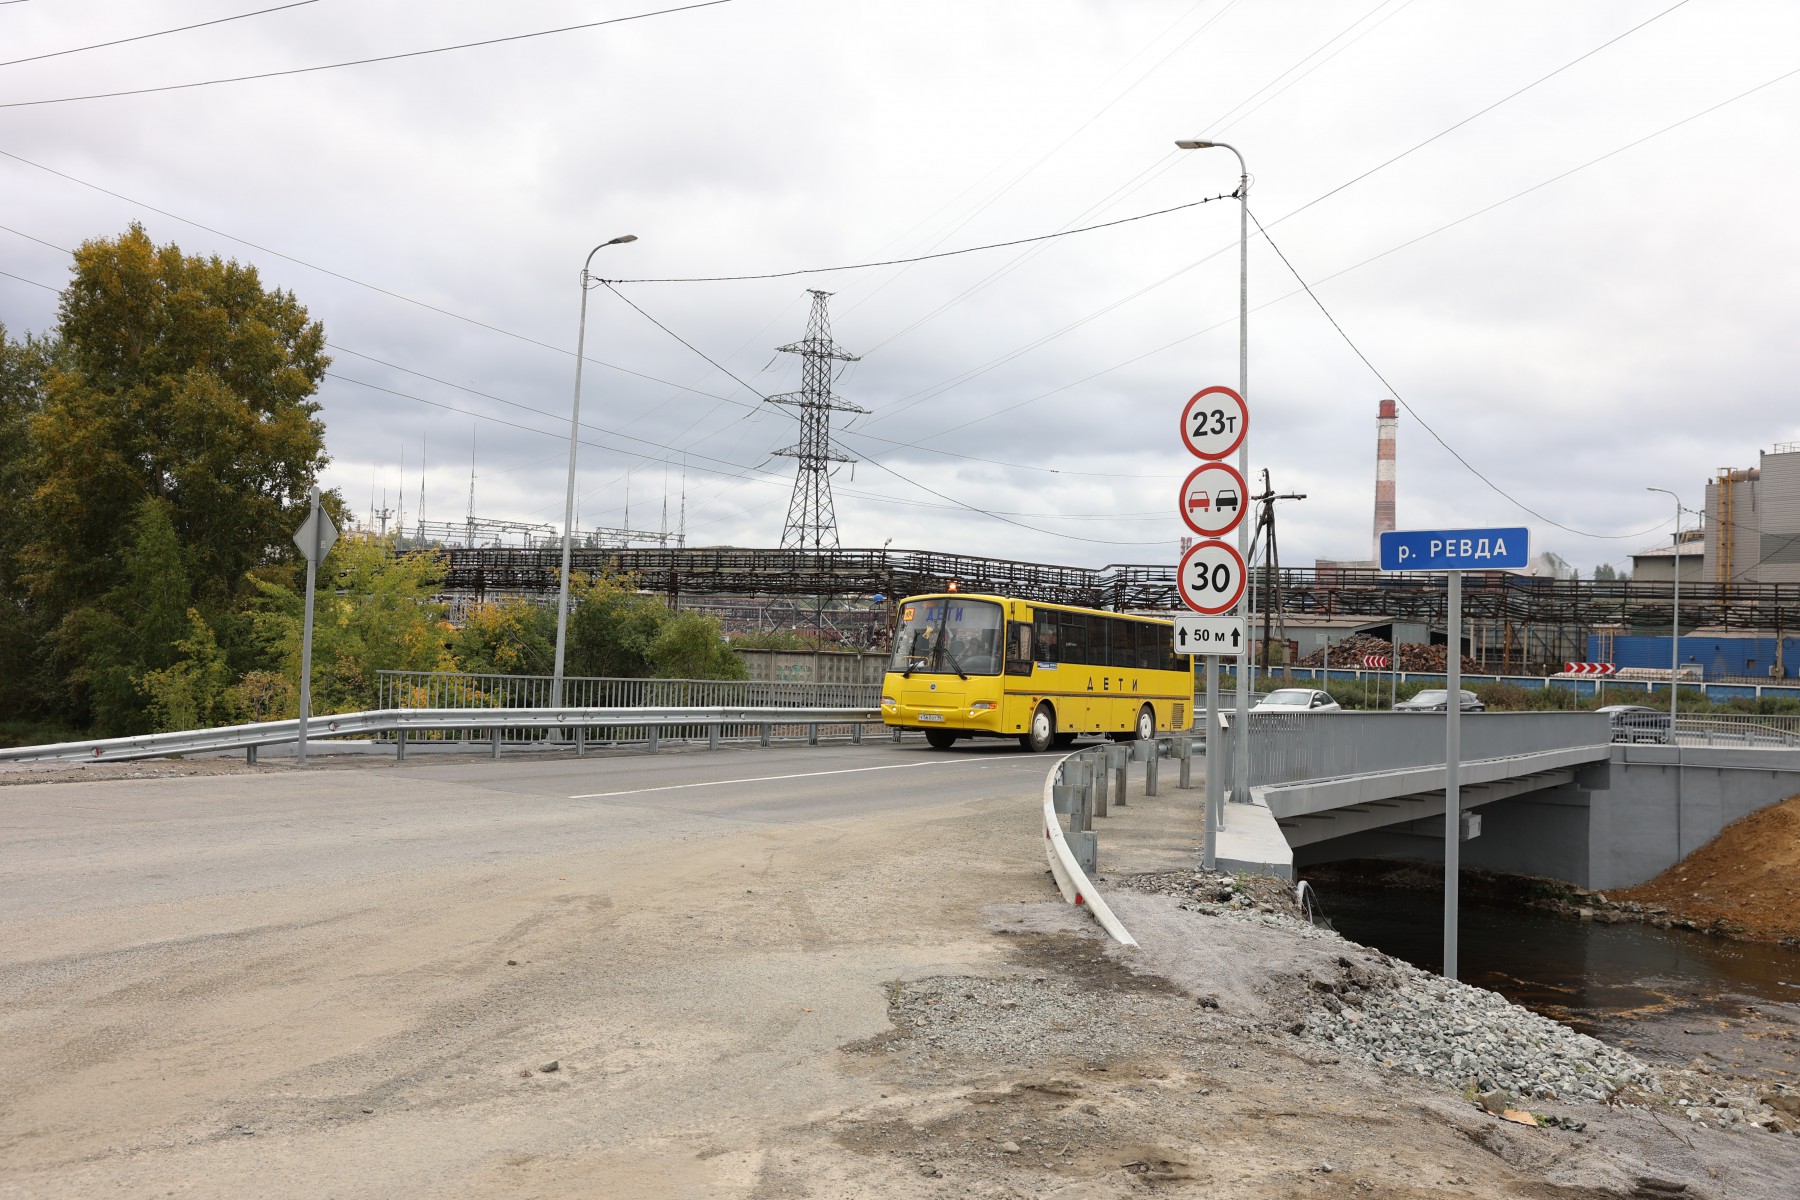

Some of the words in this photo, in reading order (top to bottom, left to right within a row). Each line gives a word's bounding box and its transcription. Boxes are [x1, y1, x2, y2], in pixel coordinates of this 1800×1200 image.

[1398, 545, 1416, 563] р.
[1430, 538, 1507, 559] РЕВДА
[1191, 561, 1231, 593] 30
[926, 606, 964, 622] ДЕТИ
[1193, 629, 1210, 641] 50
[1087, 676, 1138, 691] ДЕТИ
